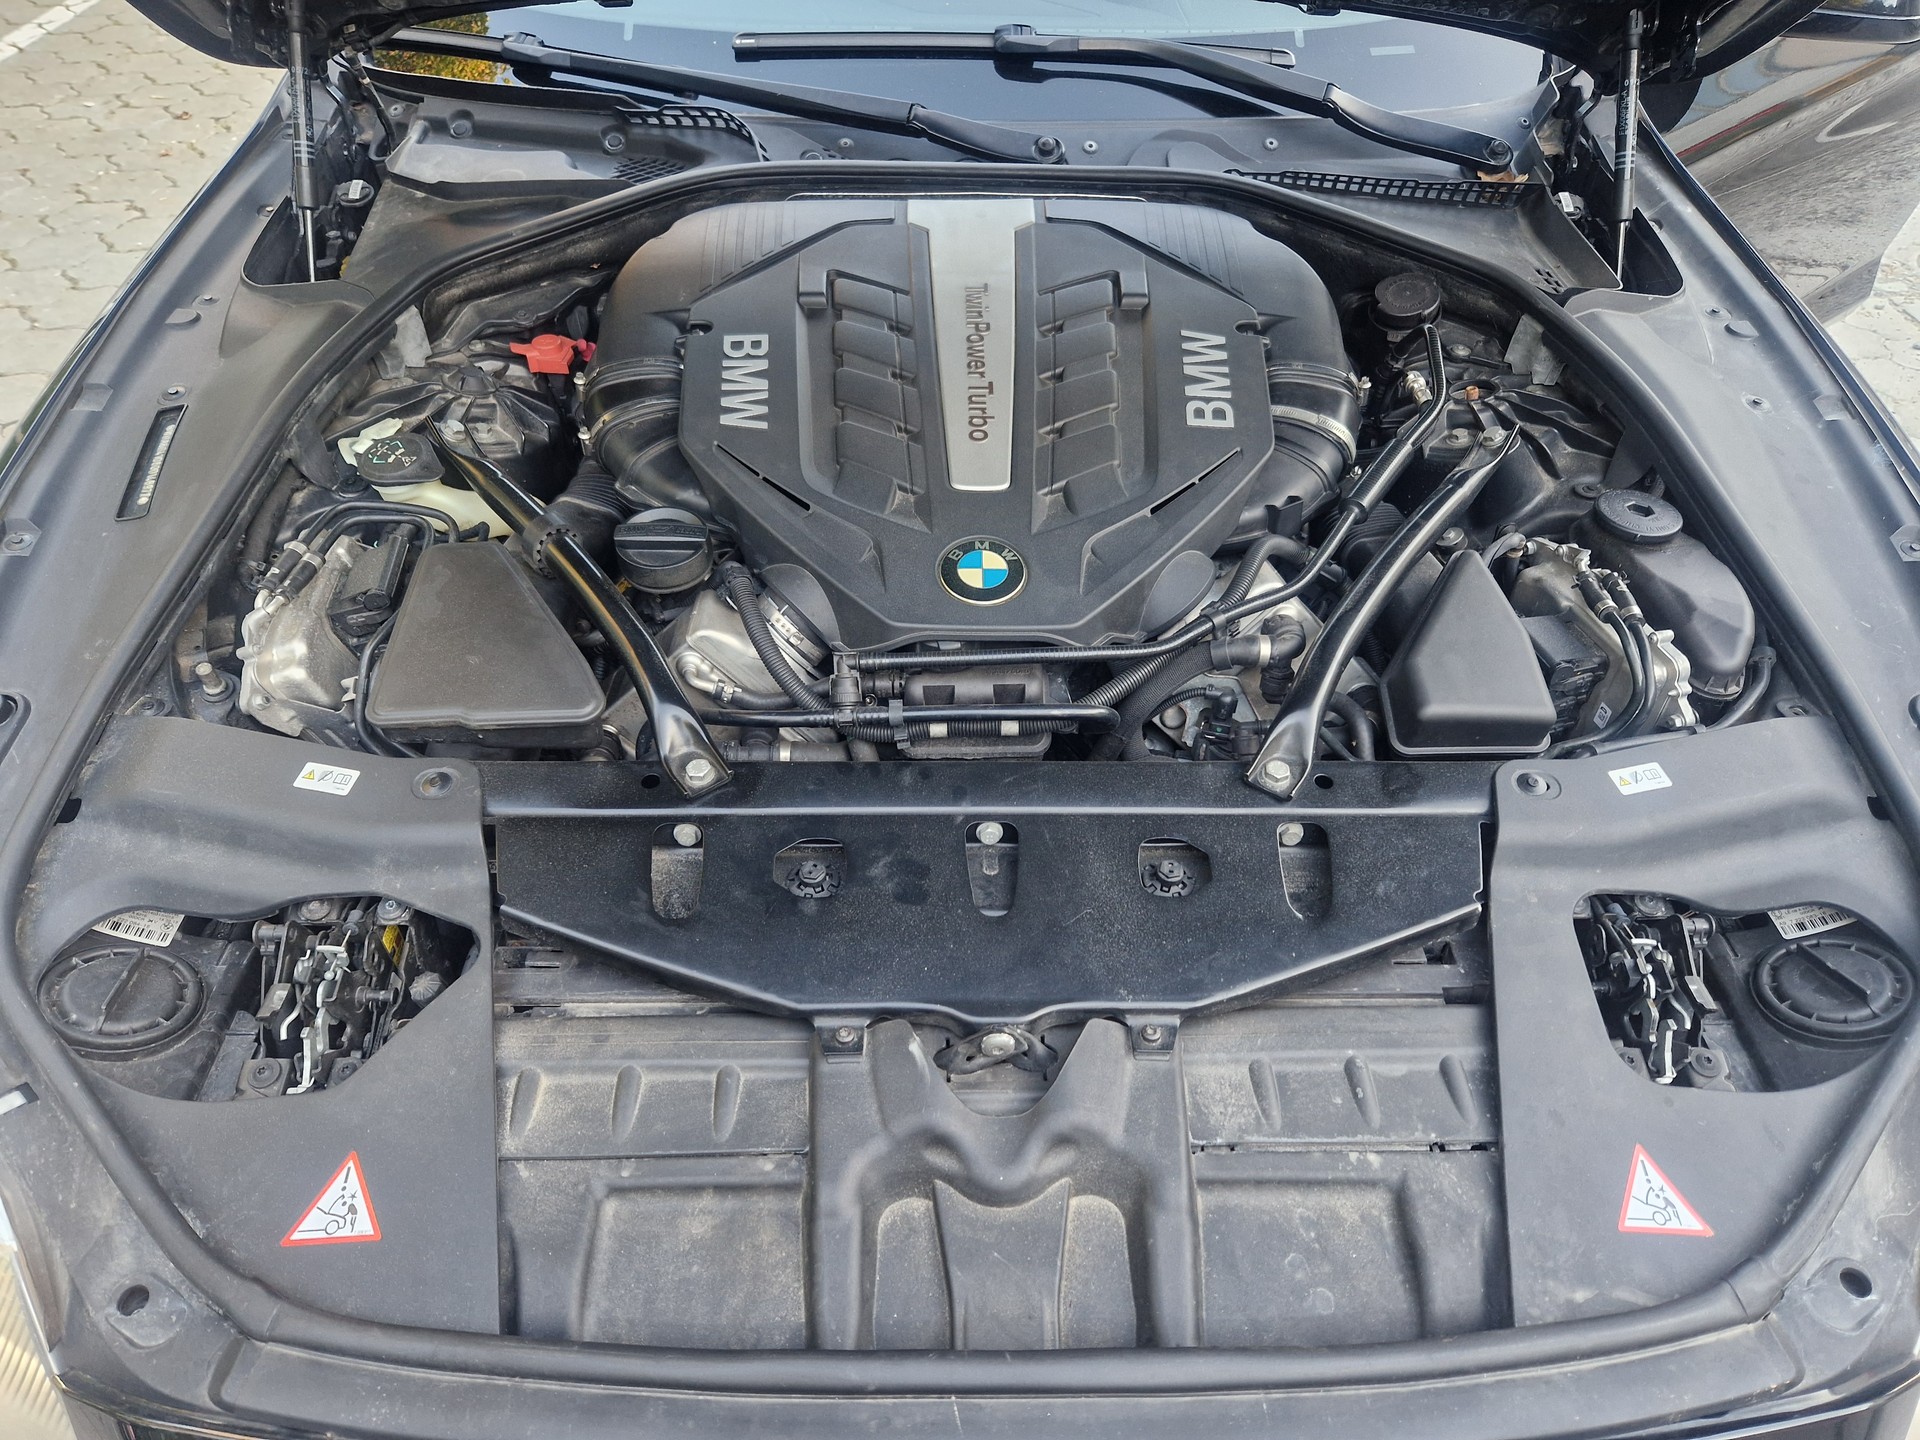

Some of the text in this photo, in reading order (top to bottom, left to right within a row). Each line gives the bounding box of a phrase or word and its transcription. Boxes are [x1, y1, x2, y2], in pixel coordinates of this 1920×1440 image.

[720, 334, 769, 429] BMW
[965, 283, 995, 442] TwinPower Turbo
[1181, 330, 1234, 427] BMW
[948, 541, 1018, 560] BMW
